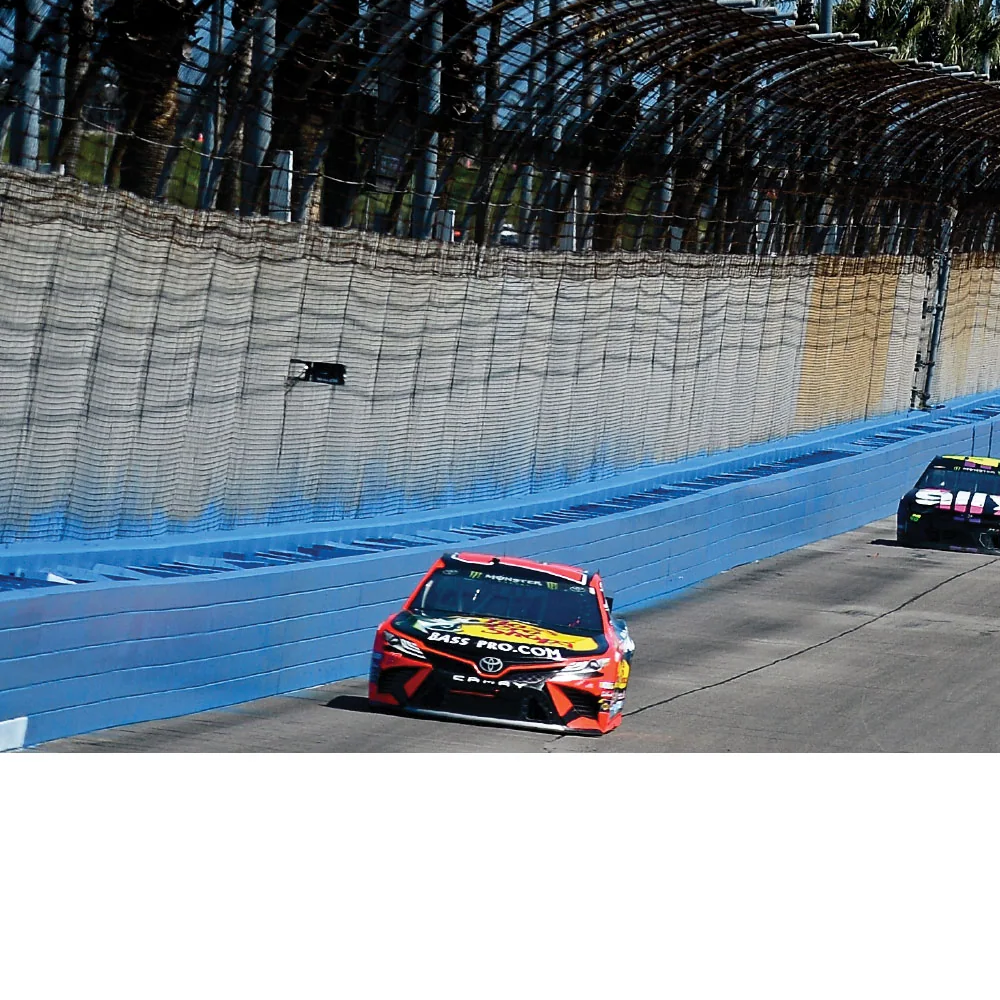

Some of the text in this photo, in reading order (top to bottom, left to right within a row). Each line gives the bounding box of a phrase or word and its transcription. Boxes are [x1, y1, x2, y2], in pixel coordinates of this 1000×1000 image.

[485, 574, 543, 587] MONSTER
[427, 632, 562, 660] BASS PRO.COM
